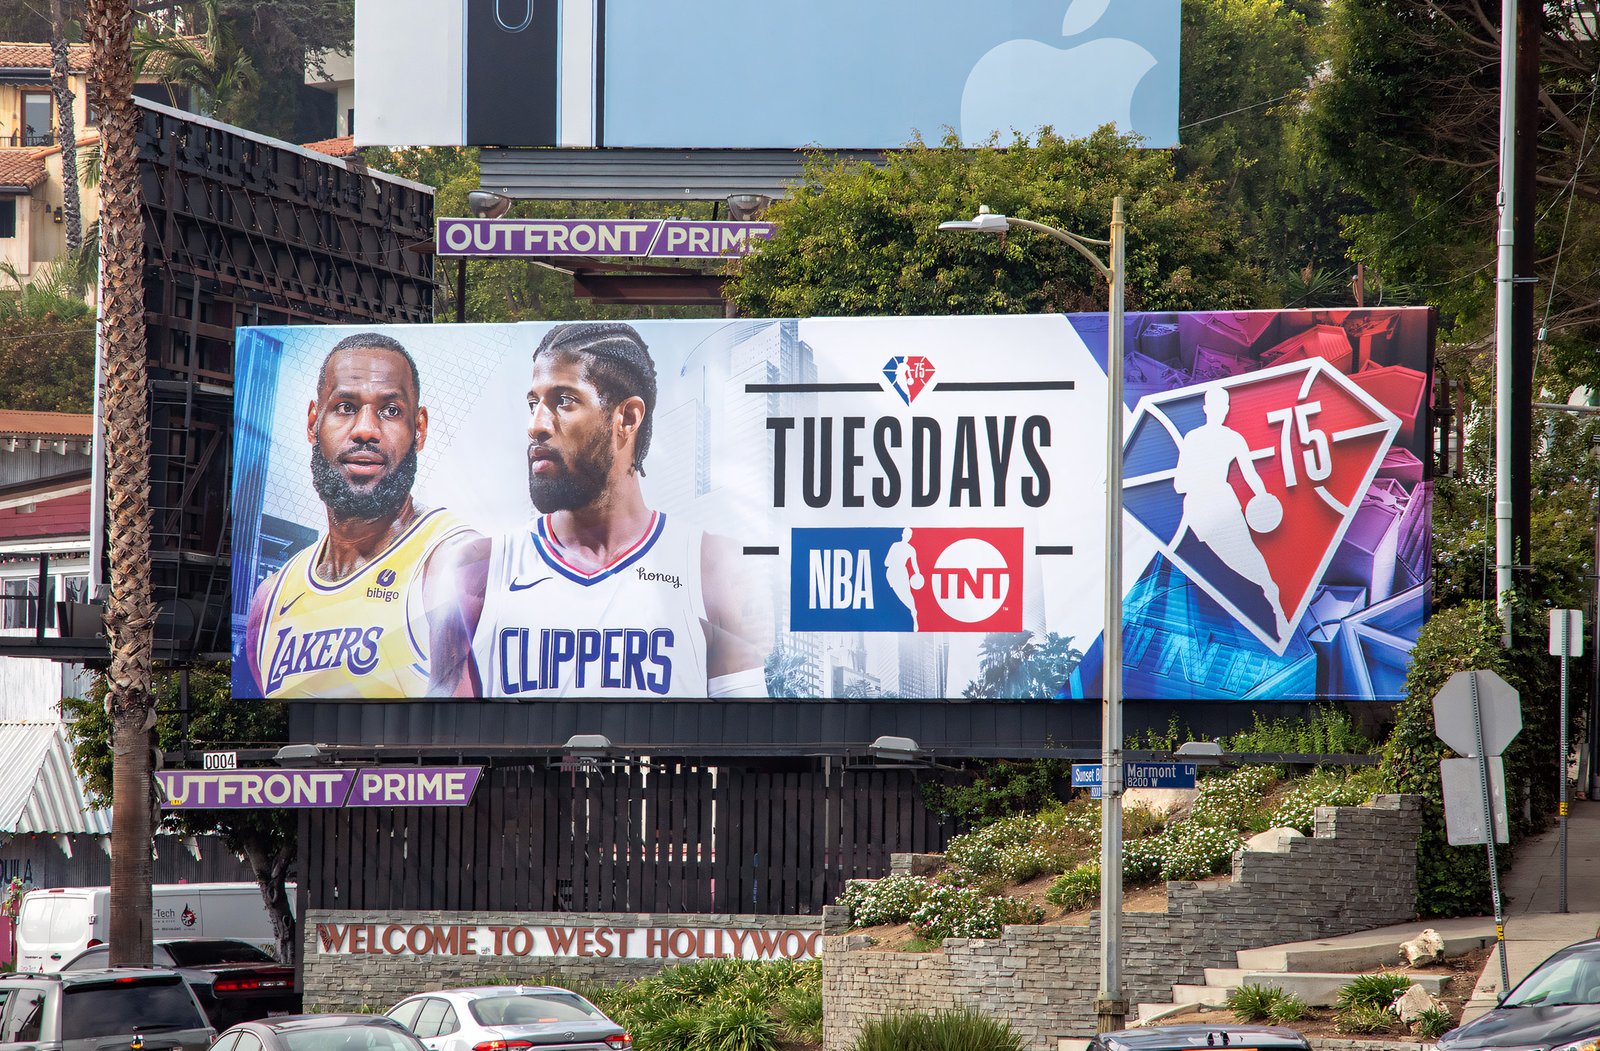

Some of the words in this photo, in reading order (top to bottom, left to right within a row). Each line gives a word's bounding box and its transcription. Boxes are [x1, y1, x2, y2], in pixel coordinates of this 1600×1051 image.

[445, 223, 649, 251] OUTFRONT
[913, 362, 925, 379] 75
[1266, 400, 1332, 488] 75
[766, 415, 1051, 508] TUESDAYS
[636, 566, 682, 589] honey
[809, 549, 874, 609] NBA
[933, 567, 1009, 600] TNT
[366, 587, 399, 602] bibigo
[265, 626, 384, 696] LAKERS
[499, 627, 675, 695] CLIPPERS
[205, 754, 235, 769] 0004
[1075, 768, 1095, 782] Sunset
[1127, 764, 1176, 778] Marmont
[1185, 765, 1194, 775] Ln
[155, 773, 344, 804] UTFRONT
[362, 773, 466, 801] PRIME
[1127, 778, 1148, 787] 8200
[1151, 778, 1158, 787] W
[317, 924, 476, 956] WELCOME
[488, 926, 534, 956] TO
[545, 927, 634, 958] WEST
